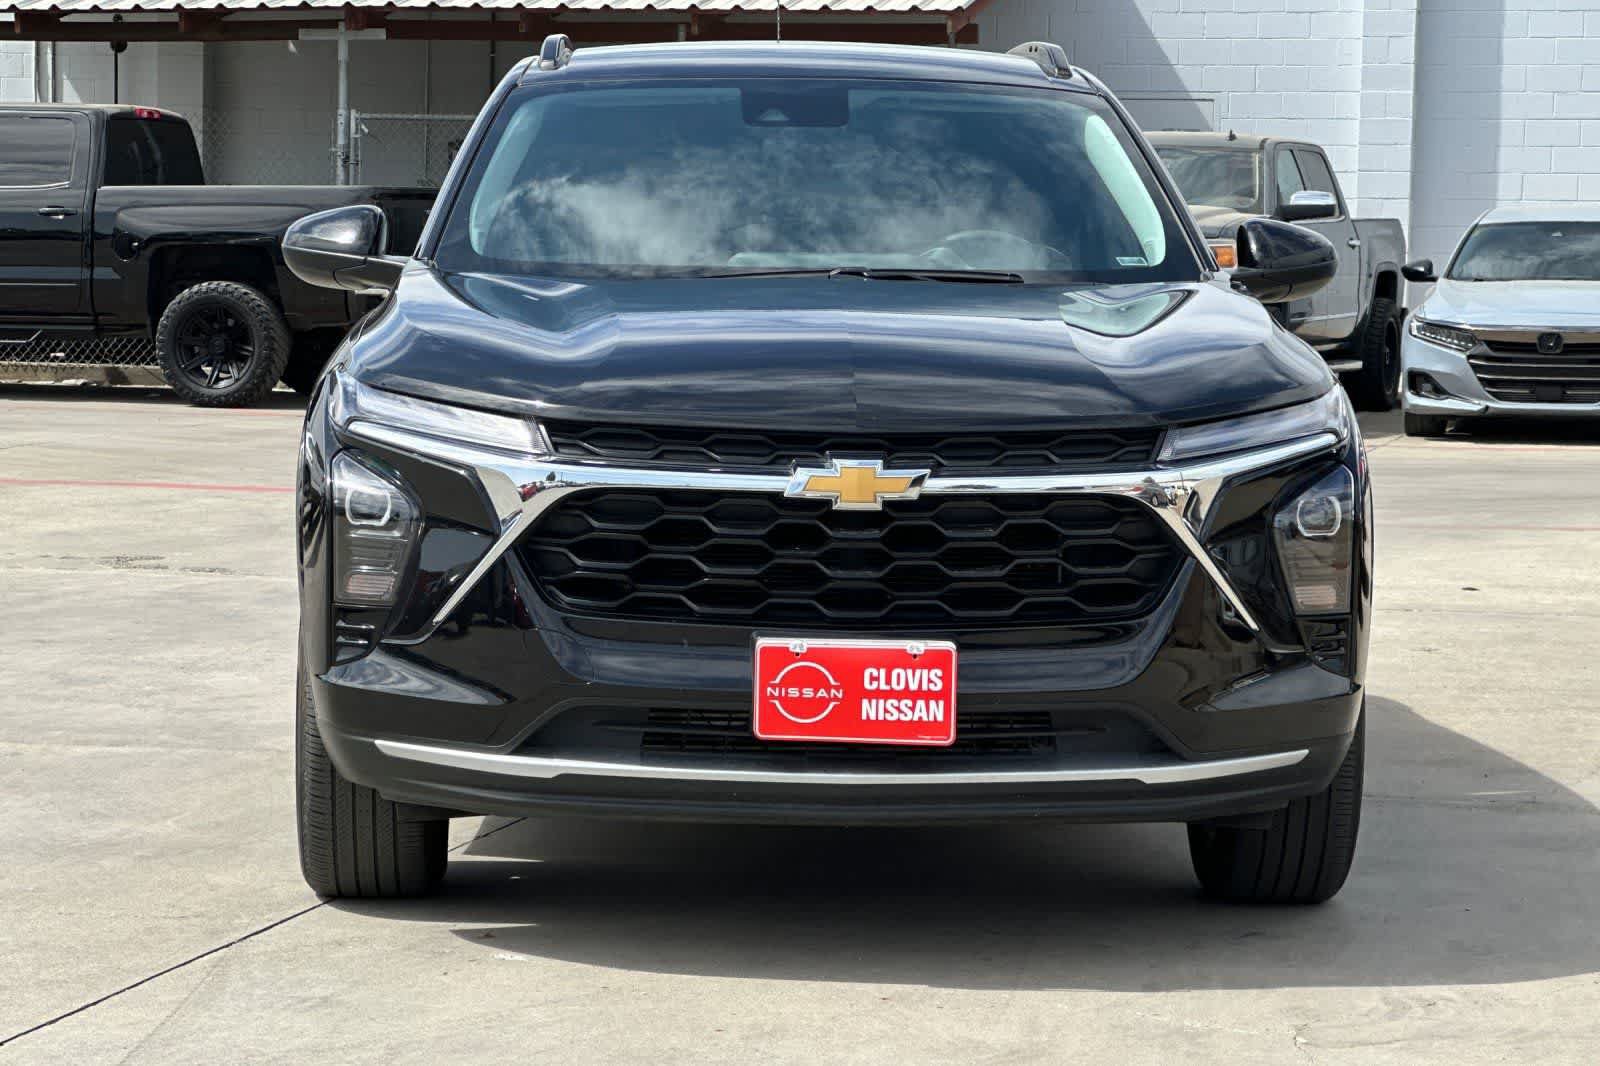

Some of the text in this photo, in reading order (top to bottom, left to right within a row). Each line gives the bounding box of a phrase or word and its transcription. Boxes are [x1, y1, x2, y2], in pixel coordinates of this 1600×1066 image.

[863, 667, 943, 692] CLOVIS
[766, 686, 844, 700] NISSAN
[861, 698, 944, 722] NISSAN
